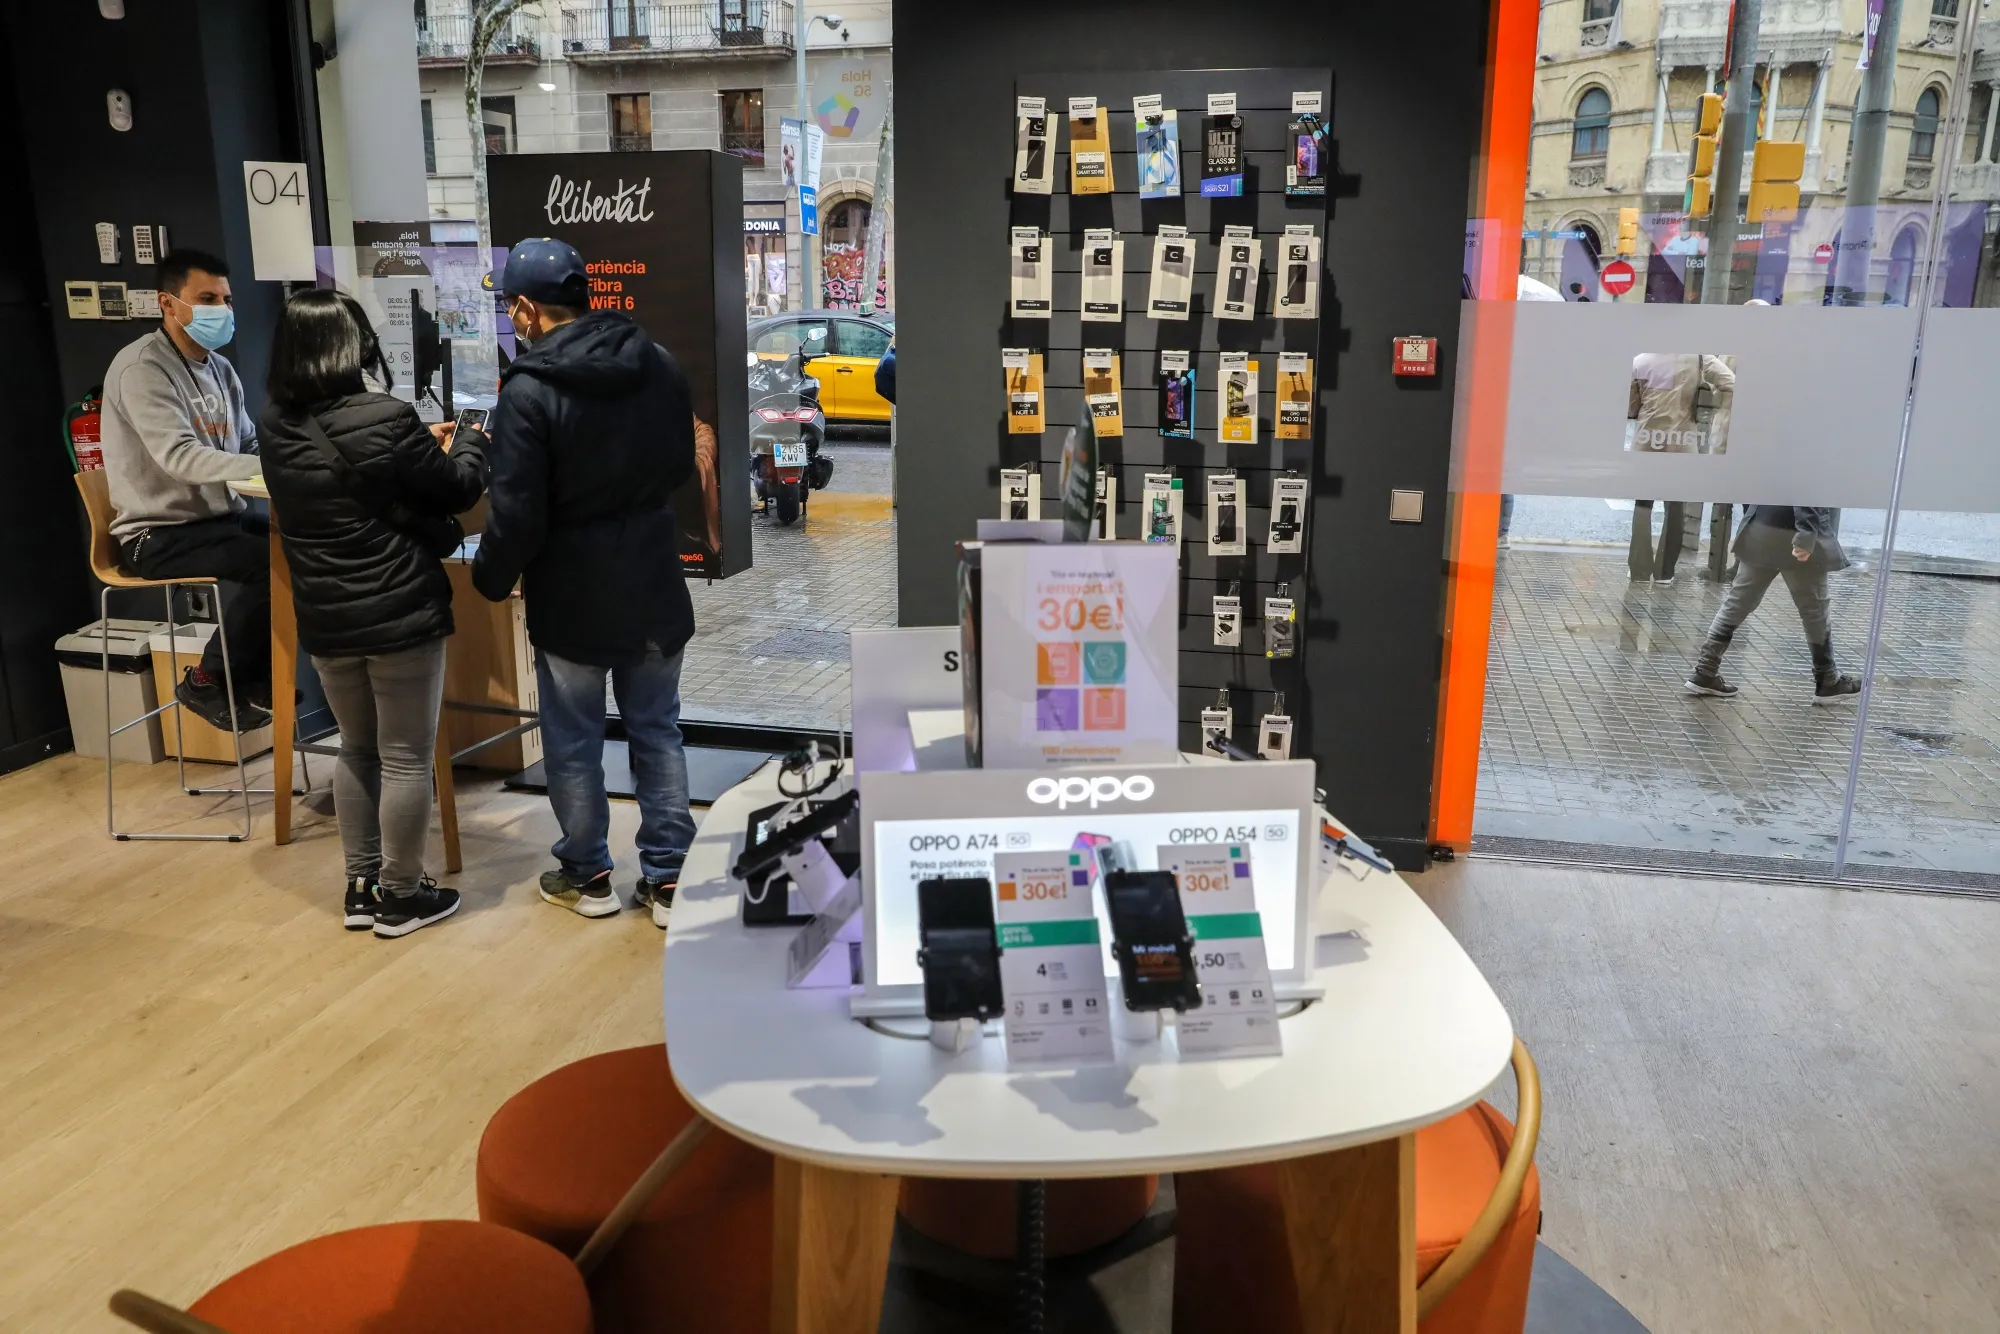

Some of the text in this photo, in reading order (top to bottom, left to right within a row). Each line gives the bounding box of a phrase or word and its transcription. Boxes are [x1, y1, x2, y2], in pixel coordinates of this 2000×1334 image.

[1208, 131, 1236, 145] ULTI
[1208, 145, 1236, 158] MATE
[249, 168, 305, 206] 04
[589, 295, 635, 310] WiFi 6
[781, 444, 804, 454] 2135
[781, 454, 799, 463] KMV
[1037, 598, 1124, 631] 30€!
[909, 834, 960, 851] OPPO
[966, 833, 998, 850] A74
[1169, 826, 1218, 843] OPPO
[1224, 825, 1257, 841] A54
[1185, 873, 1229, 892] 30€!
[1022, 882, 1067, 900] 30€!
[1036, 963, 1047, 977] 4
